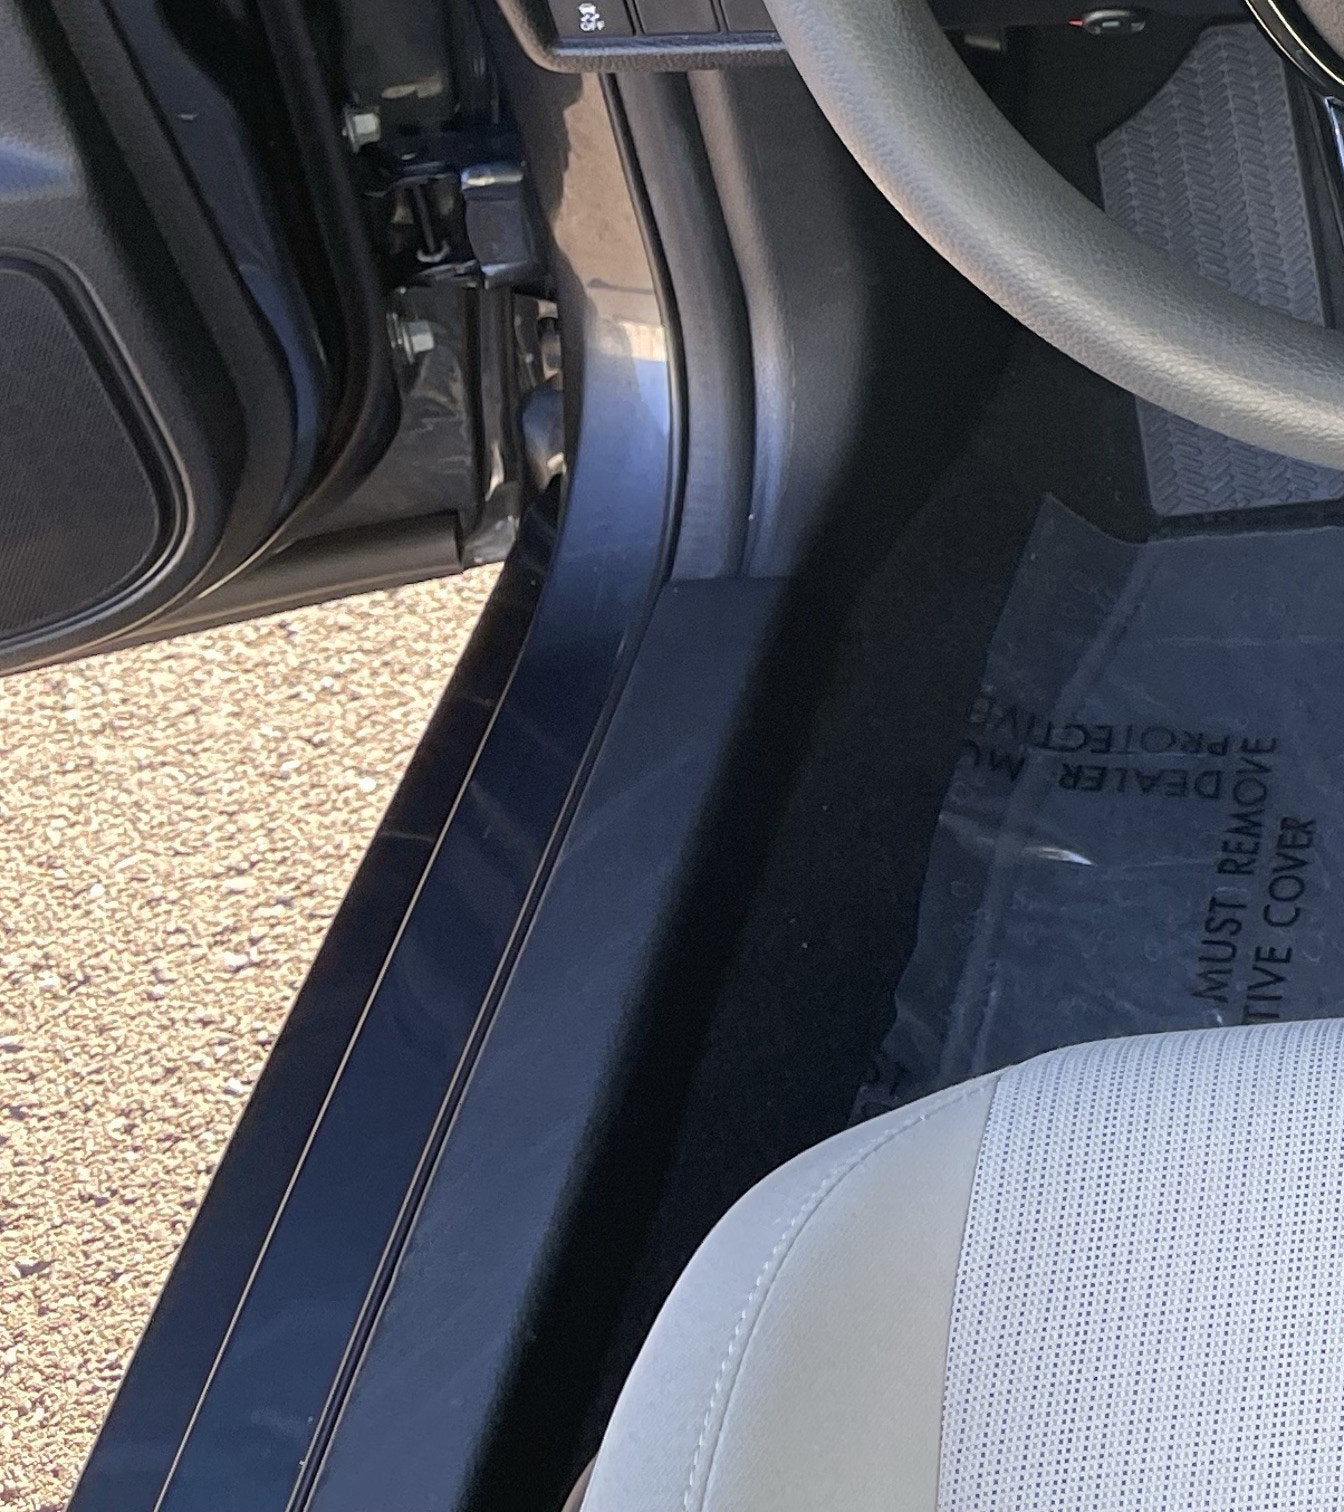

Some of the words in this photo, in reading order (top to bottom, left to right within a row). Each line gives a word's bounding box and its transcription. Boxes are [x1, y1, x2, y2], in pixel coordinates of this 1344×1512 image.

[1057, 761, 1224, 801] DEALER
[1215, 736, 1279, 877] REMOVE
[1261, 815, 1317, 929] COVER
[1189, 894, 1248, 1005] MUST
